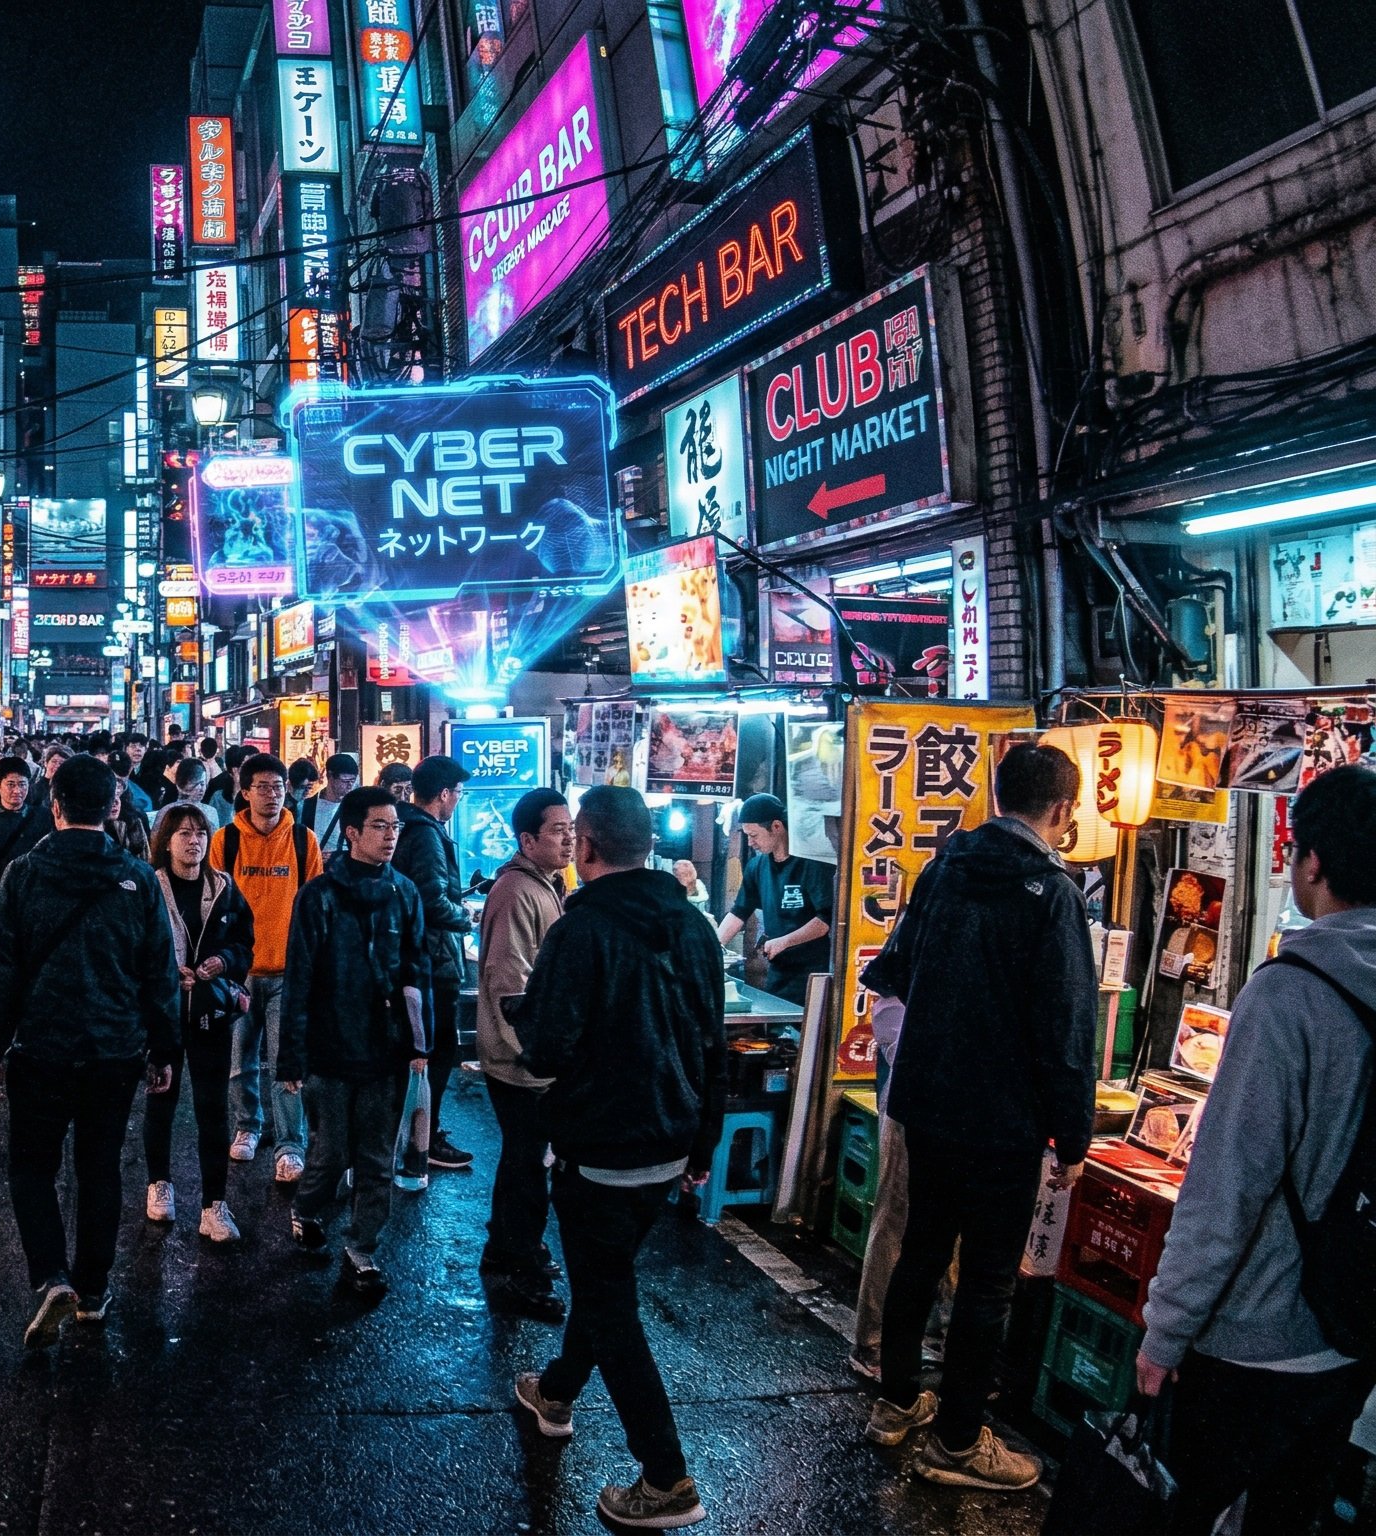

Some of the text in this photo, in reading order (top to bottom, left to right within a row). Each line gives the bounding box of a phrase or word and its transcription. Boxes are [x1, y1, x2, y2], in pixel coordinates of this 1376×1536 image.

[539, 105, 594, 193] BAR
[618, 200, 803, 370] TECH BAR
[765, 329, 884, 441] CLUB
[343, 426, 569, 475] CYBER
[764, 395, 930, 490] NIGHT MARKET
[391, 474, 525, 519] NET
[377, 522, 546, 558] ネットワーク
[462, 740, 529, 754] CYBER
[478, 753, 521, 768] NET
[1097, 731, 1123, 814] ラーメン
